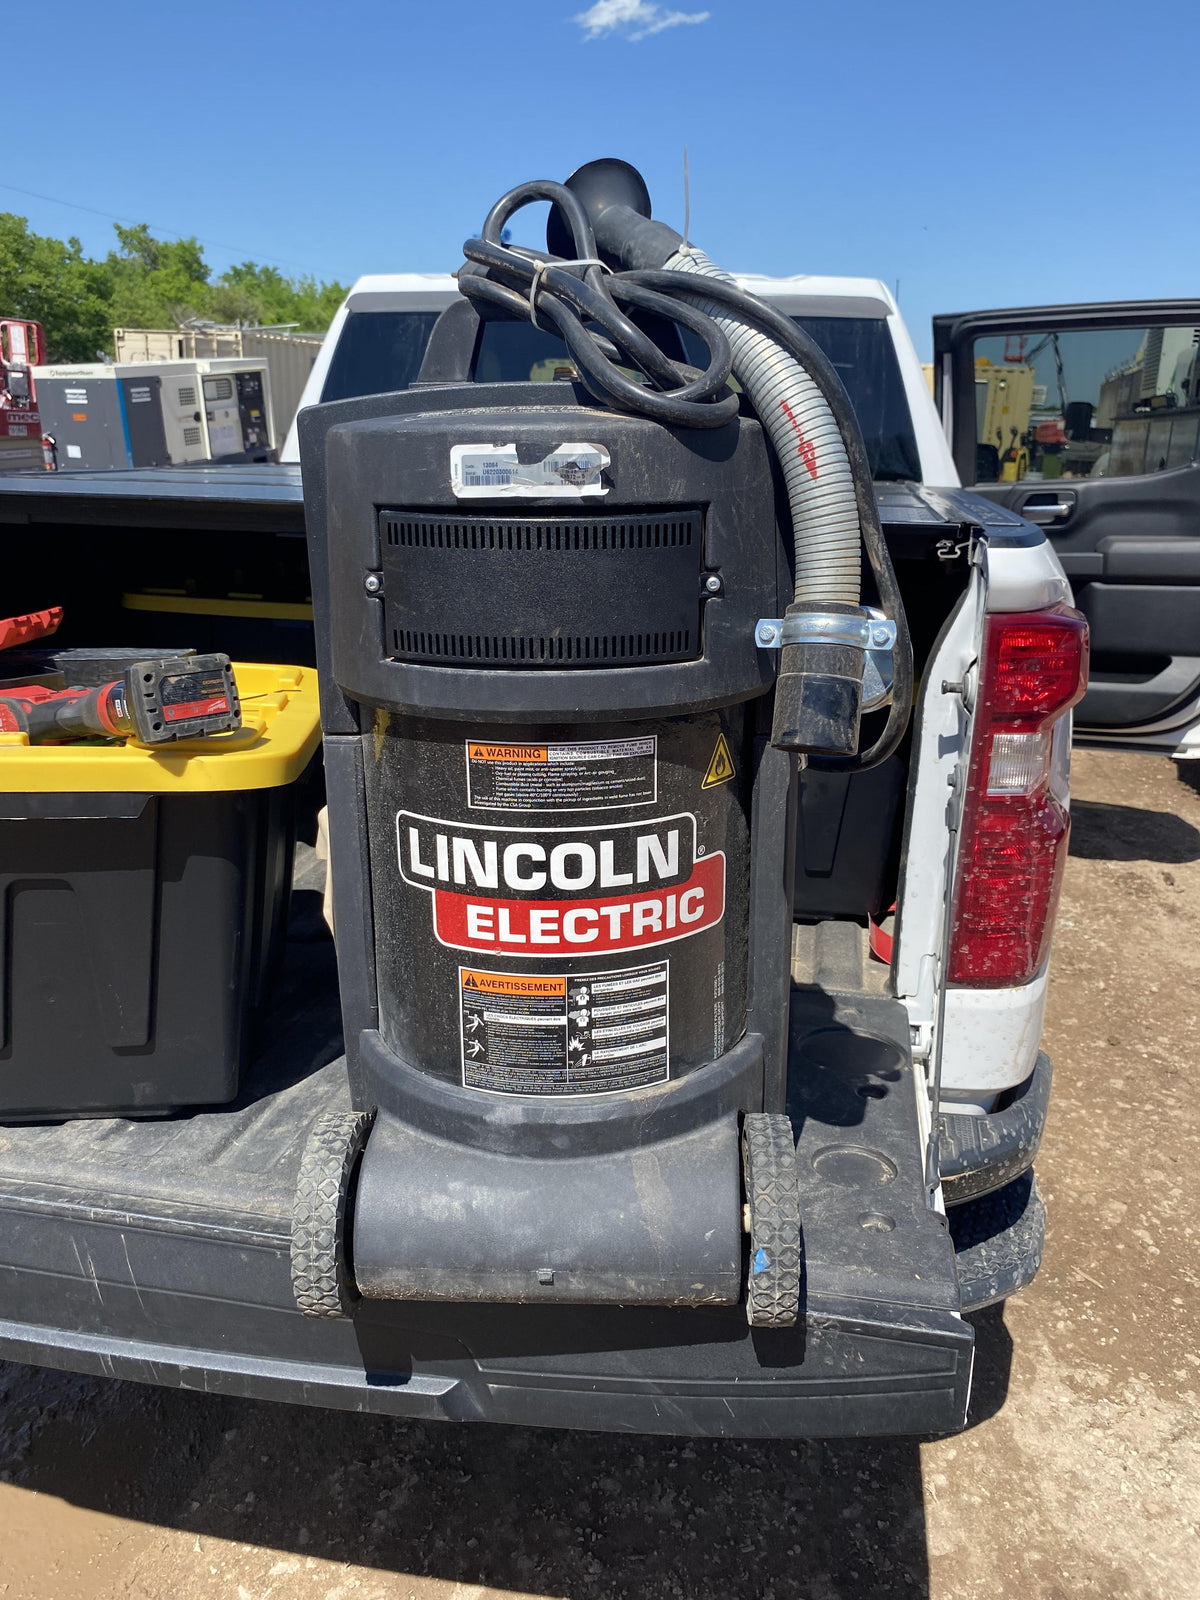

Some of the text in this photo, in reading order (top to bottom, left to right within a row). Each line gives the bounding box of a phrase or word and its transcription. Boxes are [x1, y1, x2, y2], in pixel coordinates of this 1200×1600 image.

[486, 748, 541, 759] WARNING
[409, 826, 679, 891] LINCOLN
[466, 887, 705, 944] ELECTRIC
[480, 979, 564, 992] AVERTISSEMENT
